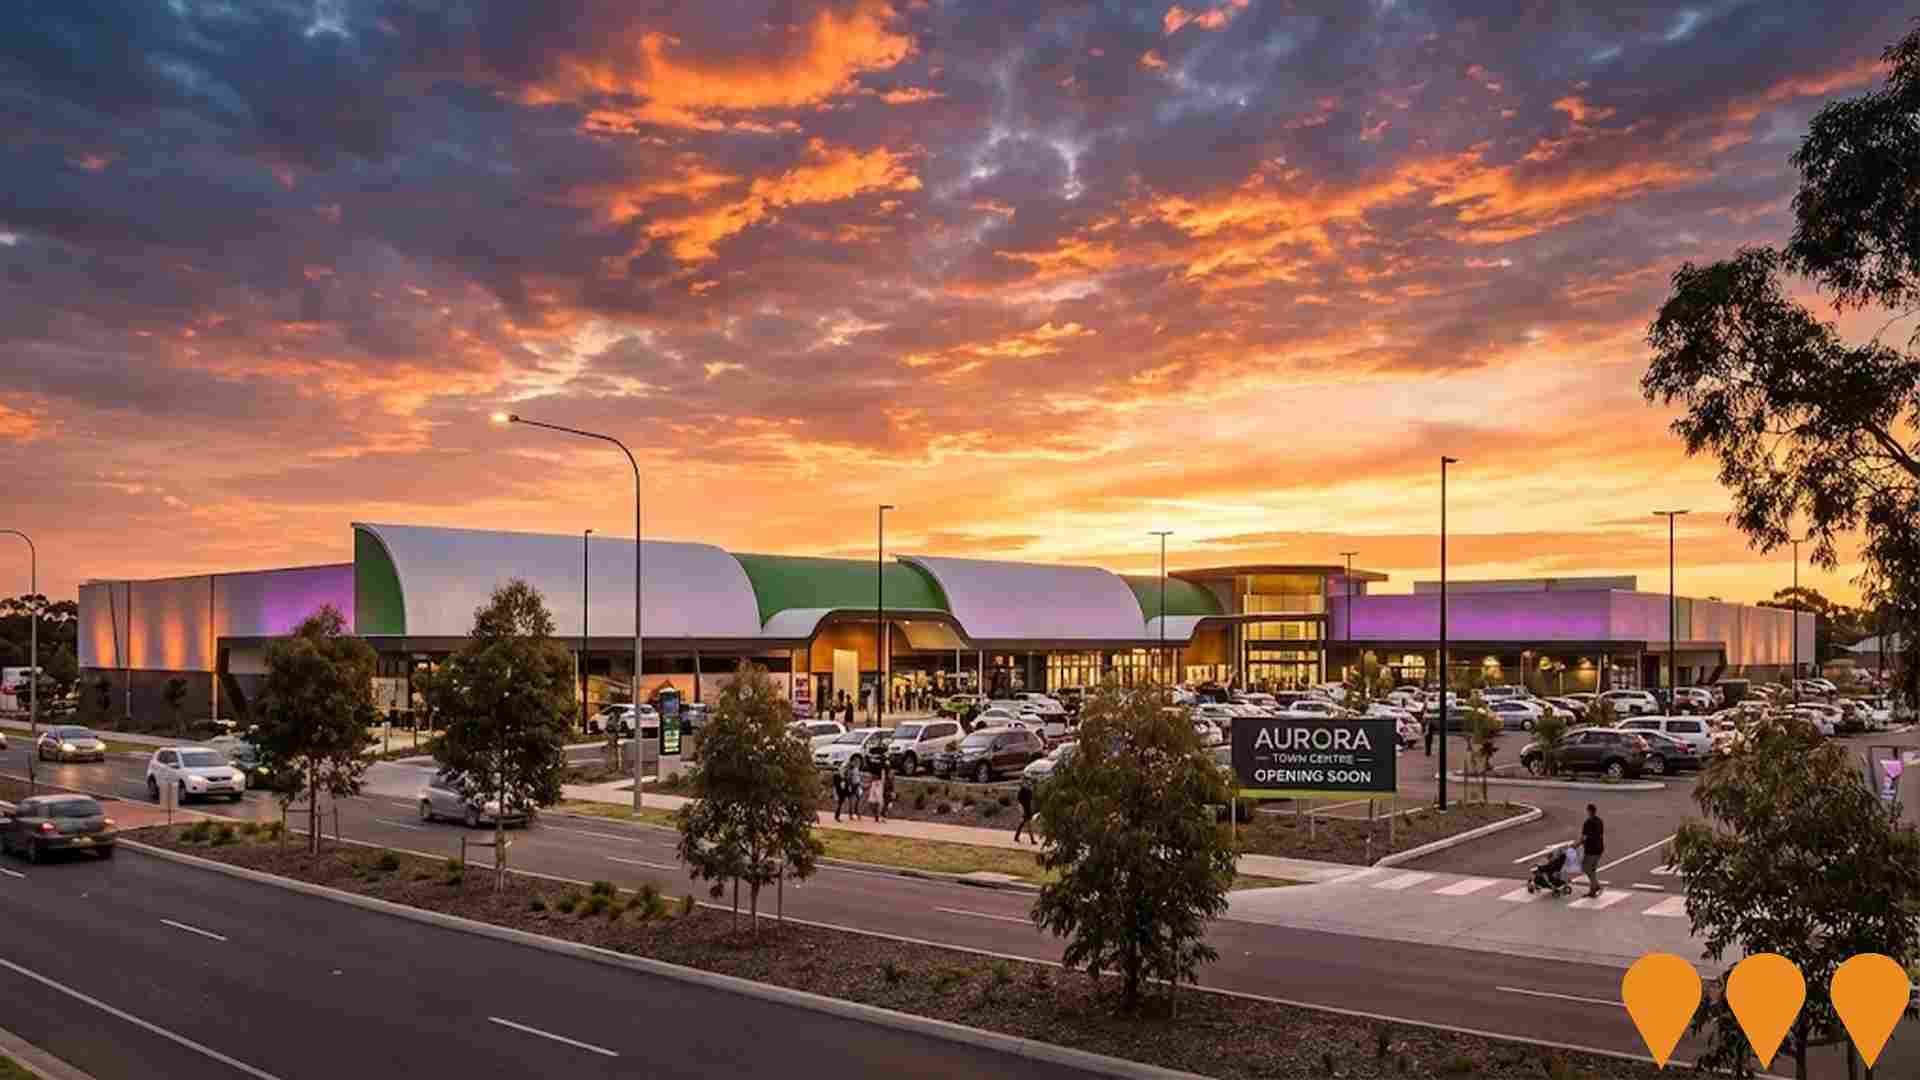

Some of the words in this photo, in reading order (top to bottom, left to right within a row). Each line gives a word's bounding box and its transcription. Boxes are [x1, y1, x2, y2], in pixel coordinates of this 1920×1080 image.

[1254, 727, 1371, 750] AURORA
[1273, 753, 1307, 764] TOWN
[1309, 753, 1354, 765] CENTRE
[1254, 769, 1324, 782] OPENING
[1327, 769, 1372, 783] SOON
